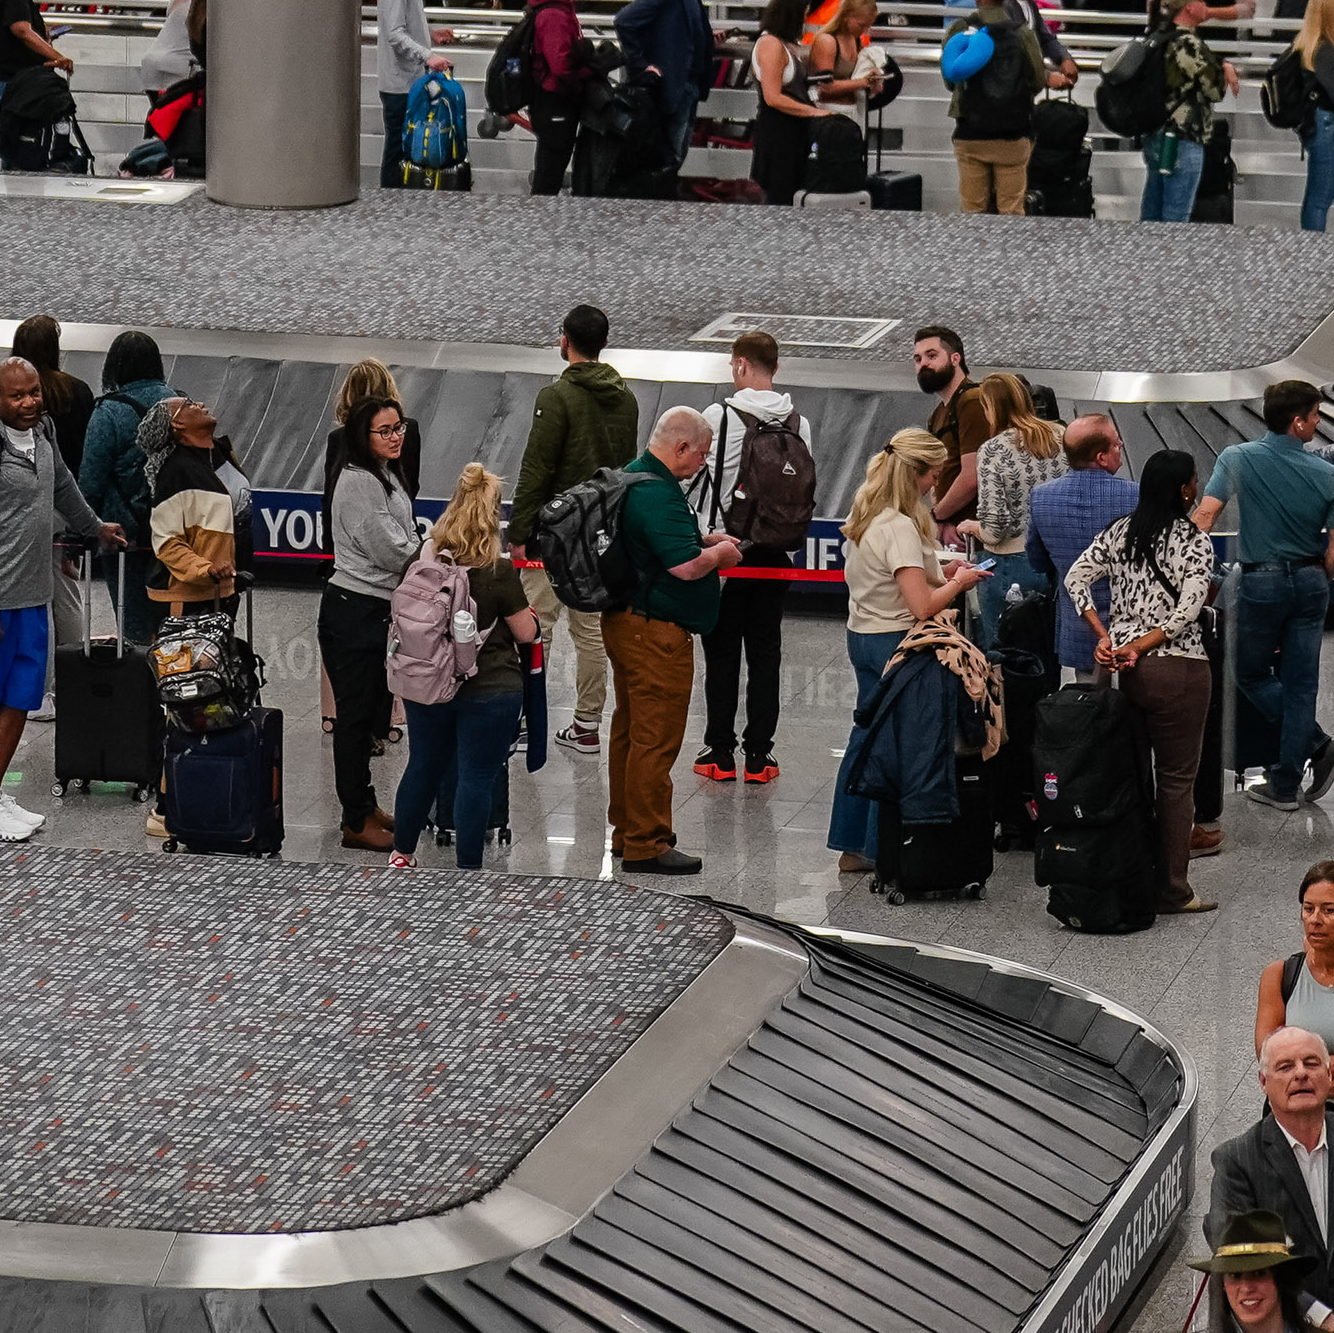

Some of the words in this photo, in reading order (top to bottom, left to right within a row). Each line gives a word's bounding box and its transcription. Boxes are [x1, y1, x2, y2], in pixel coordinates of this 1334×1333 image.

[1110, 1222, 1132, 1303] BAG
[1132, 1182, 1159, 1270] FLIES
[1160, 1145, 1184, 1228] FREE
